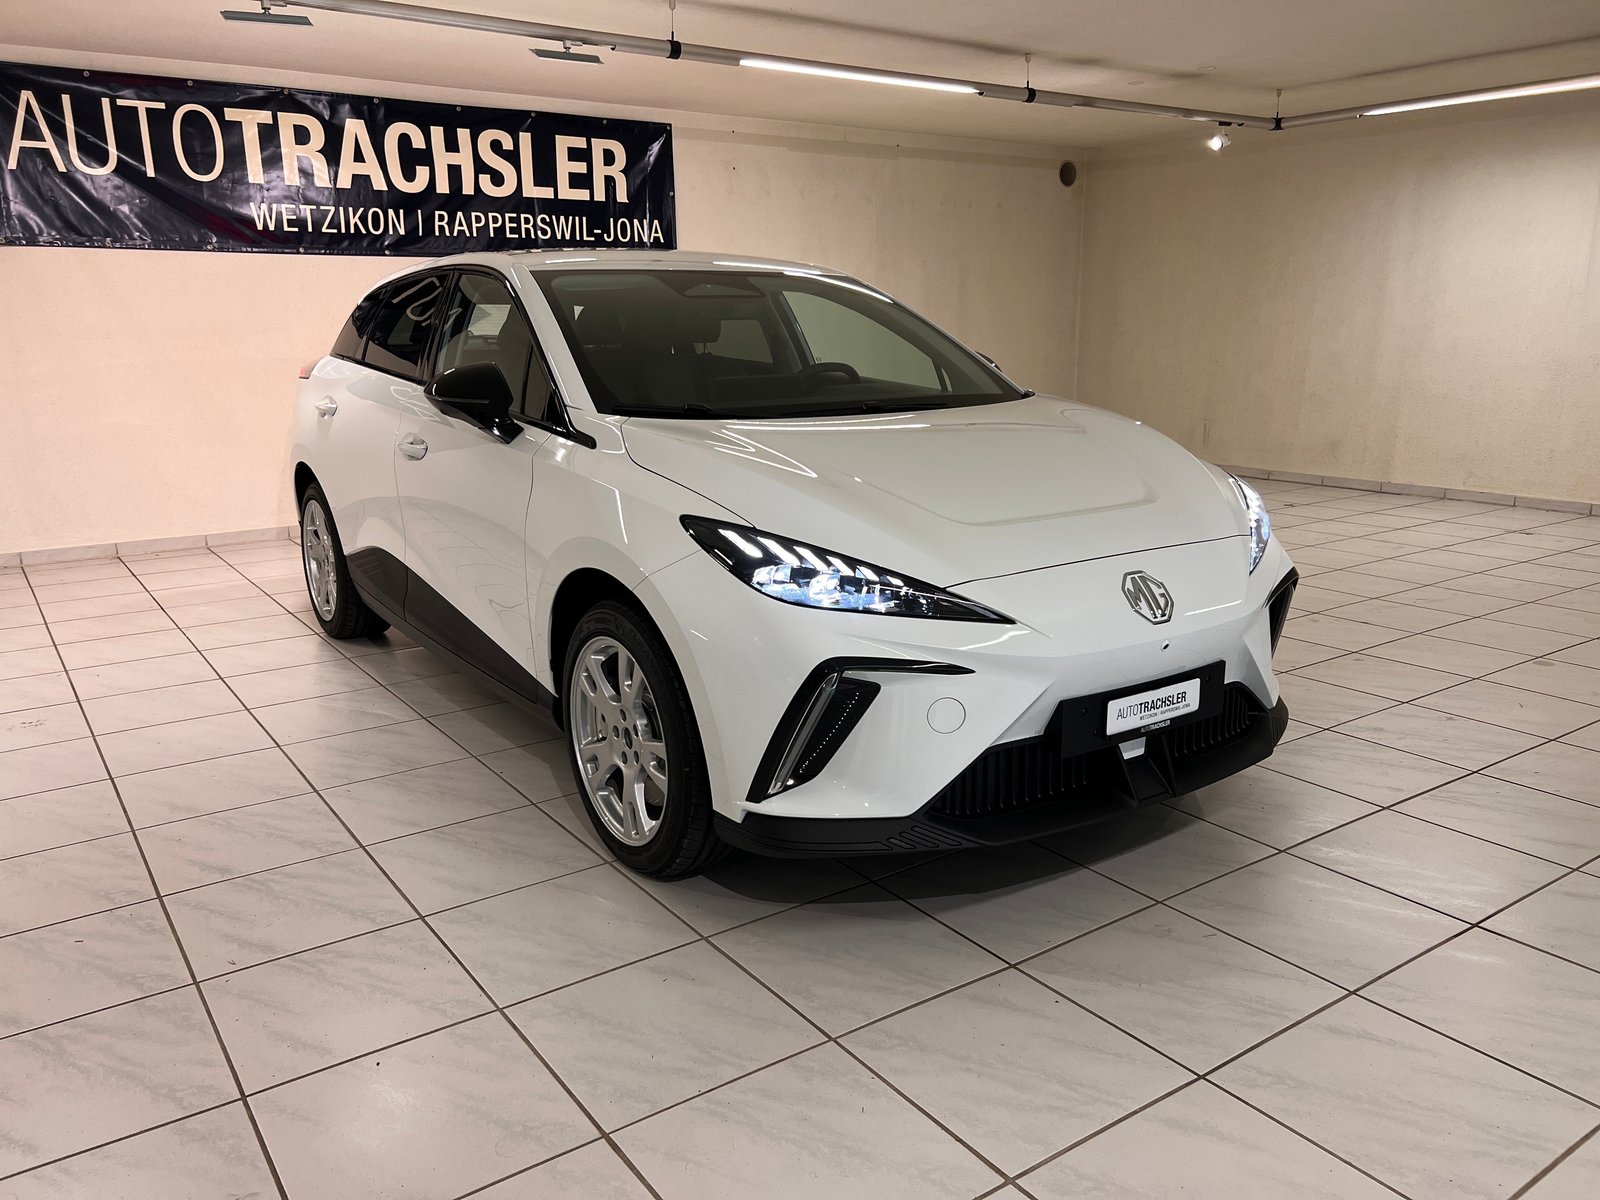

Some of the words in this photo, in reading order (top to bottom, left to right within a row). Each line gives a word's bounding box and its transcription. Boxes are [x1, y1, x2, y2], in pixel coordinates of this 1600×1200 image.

[7, 89, 629, 203] AUTOTRACHSLER
[249, 201, 405, 236] WETZIKON
[434, 210, 665, 244] RAPPERSWIL-JONA
[1125, 574, 1170, 620] MG
[1116, 691, 1187, 720] AUTOTRACHSLER
